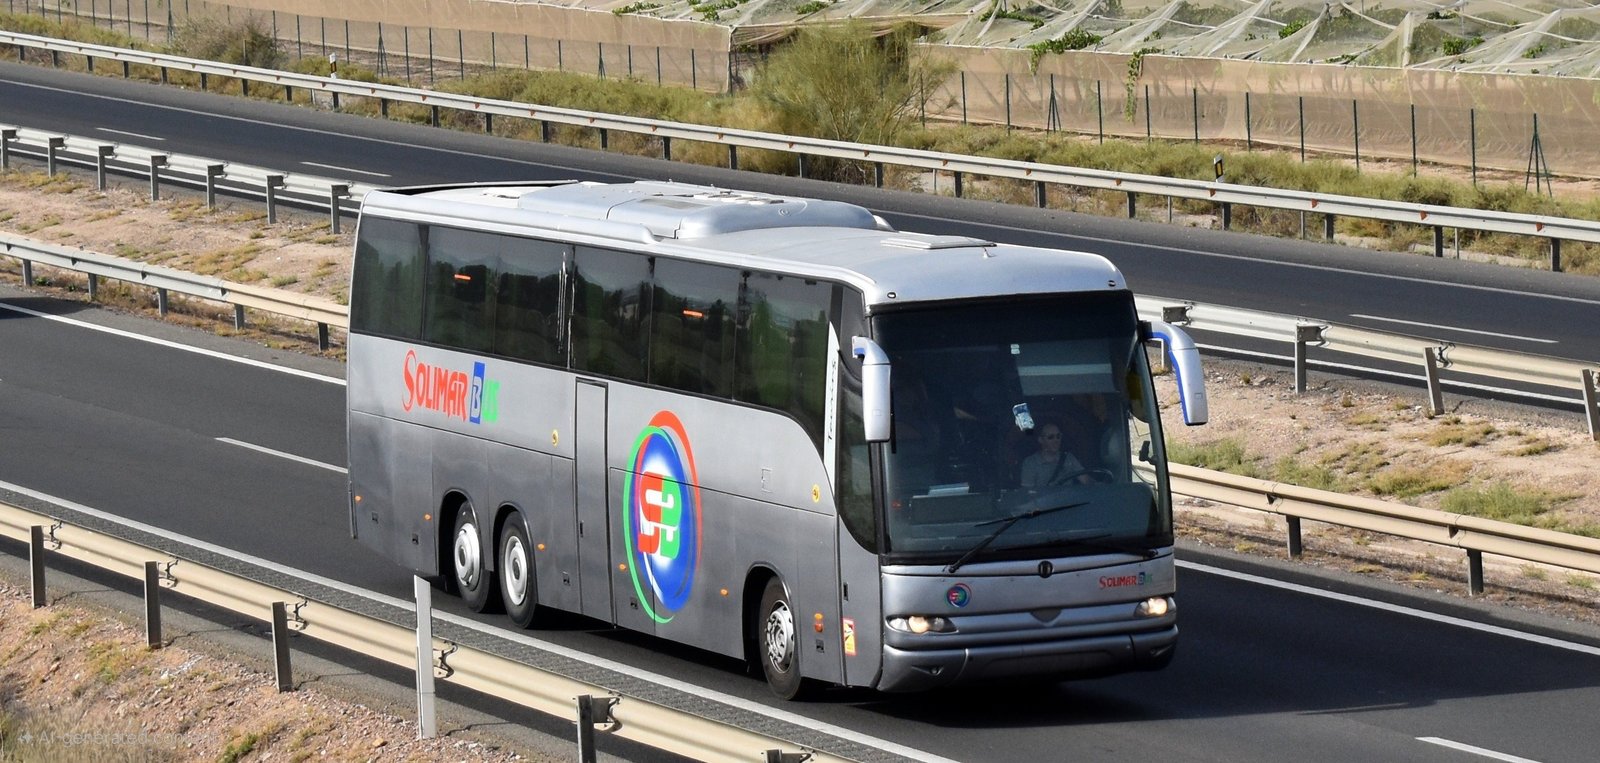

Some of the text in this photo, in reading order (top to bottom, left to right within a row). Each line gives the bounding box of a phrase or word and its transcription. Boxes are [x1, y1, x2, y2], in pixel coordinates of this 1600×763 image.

[402, 349, 500, 423] SOLIMAR BUS
[1099, 575, 1137, 589] SOLIMAR
